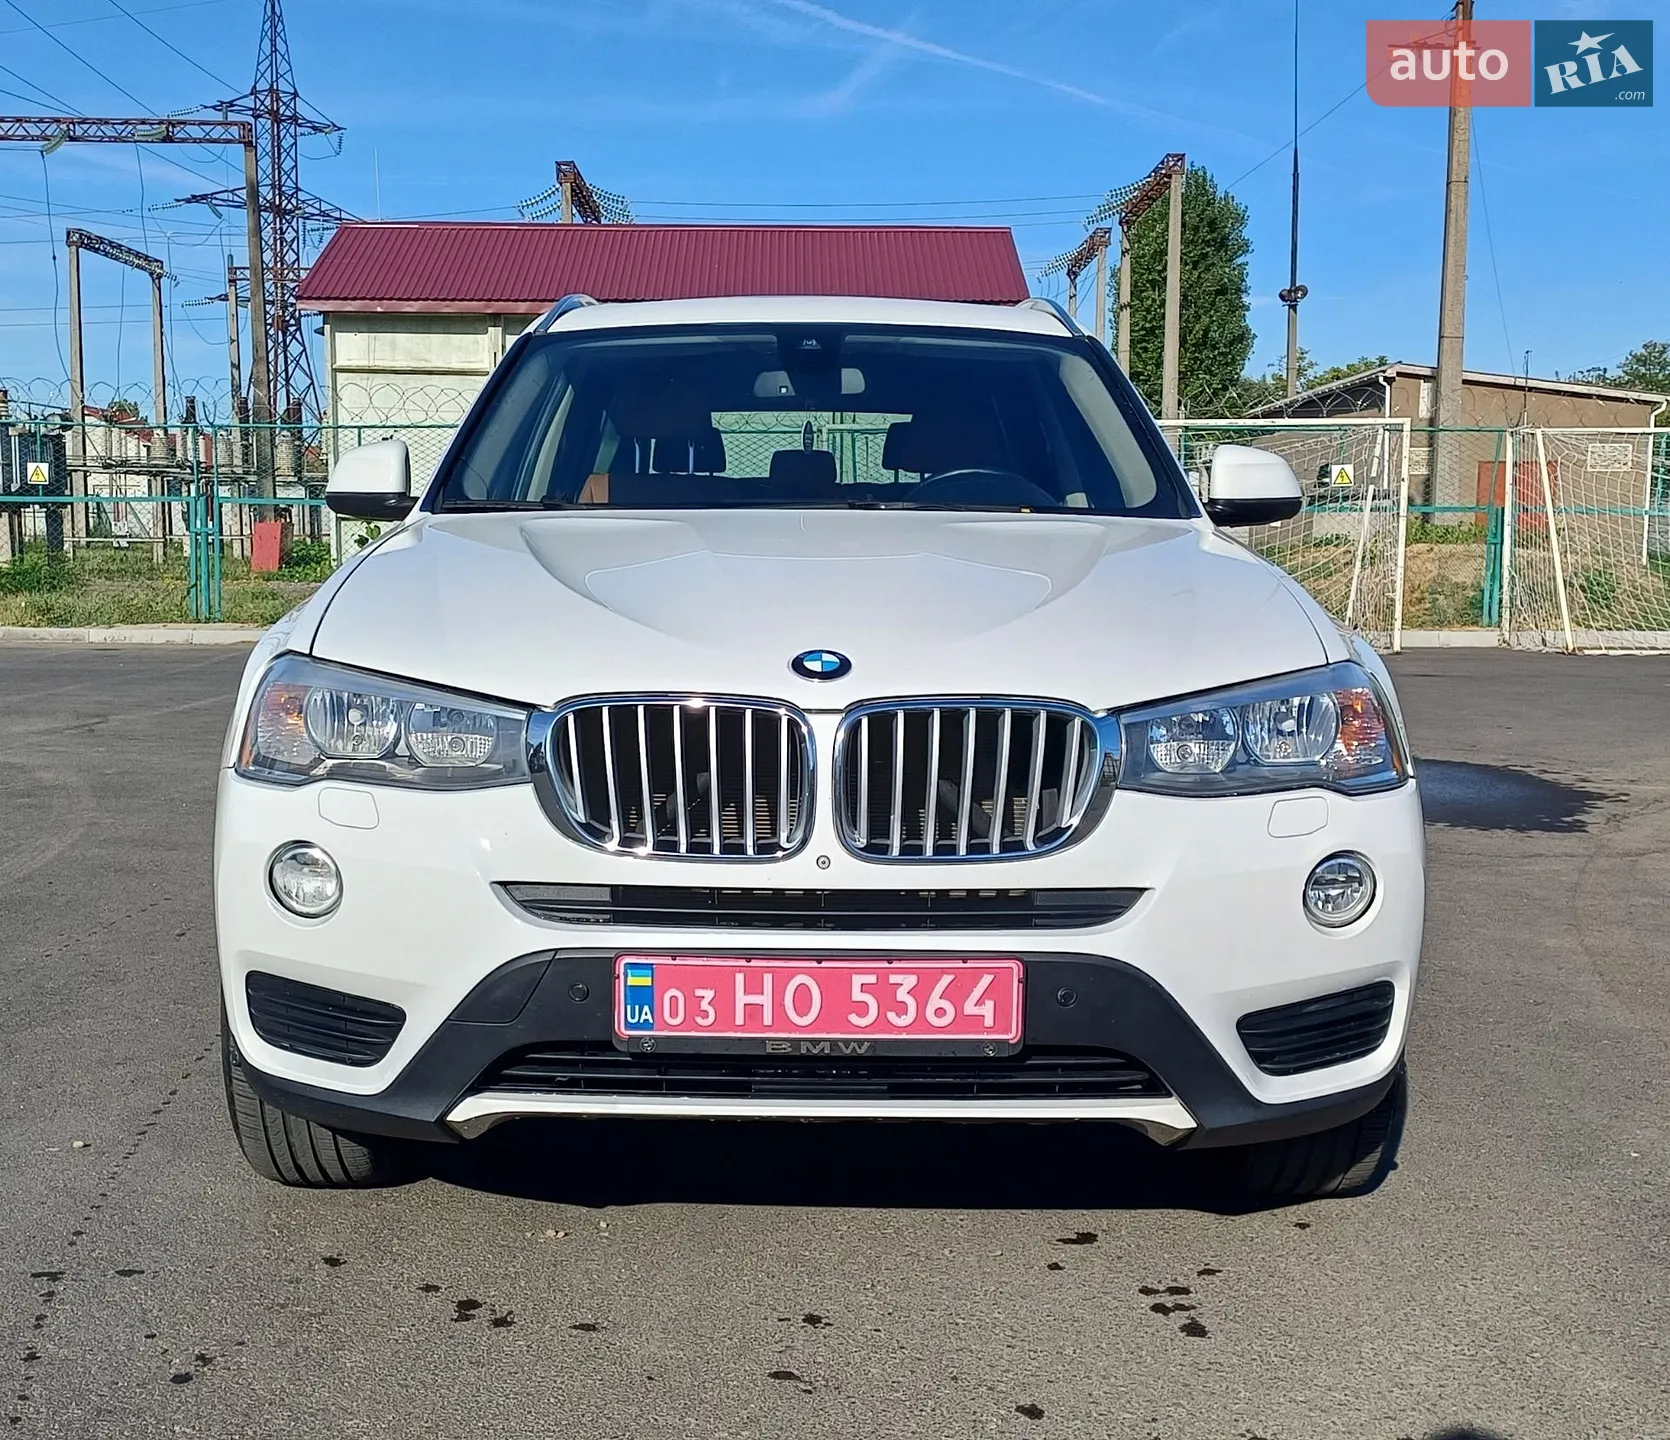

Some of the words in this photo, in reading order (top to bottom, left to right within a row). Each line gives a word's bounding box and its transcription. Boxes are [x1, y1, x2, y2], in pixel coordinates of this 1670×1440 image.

[662, 988, 716, 1026] 03
[734, 972, 822, 1027] HO
[847, 973, 995, 1028] 5364
[626, 1005, 654, 1024] UA
[766, 1040, 871, 1054] BMW
